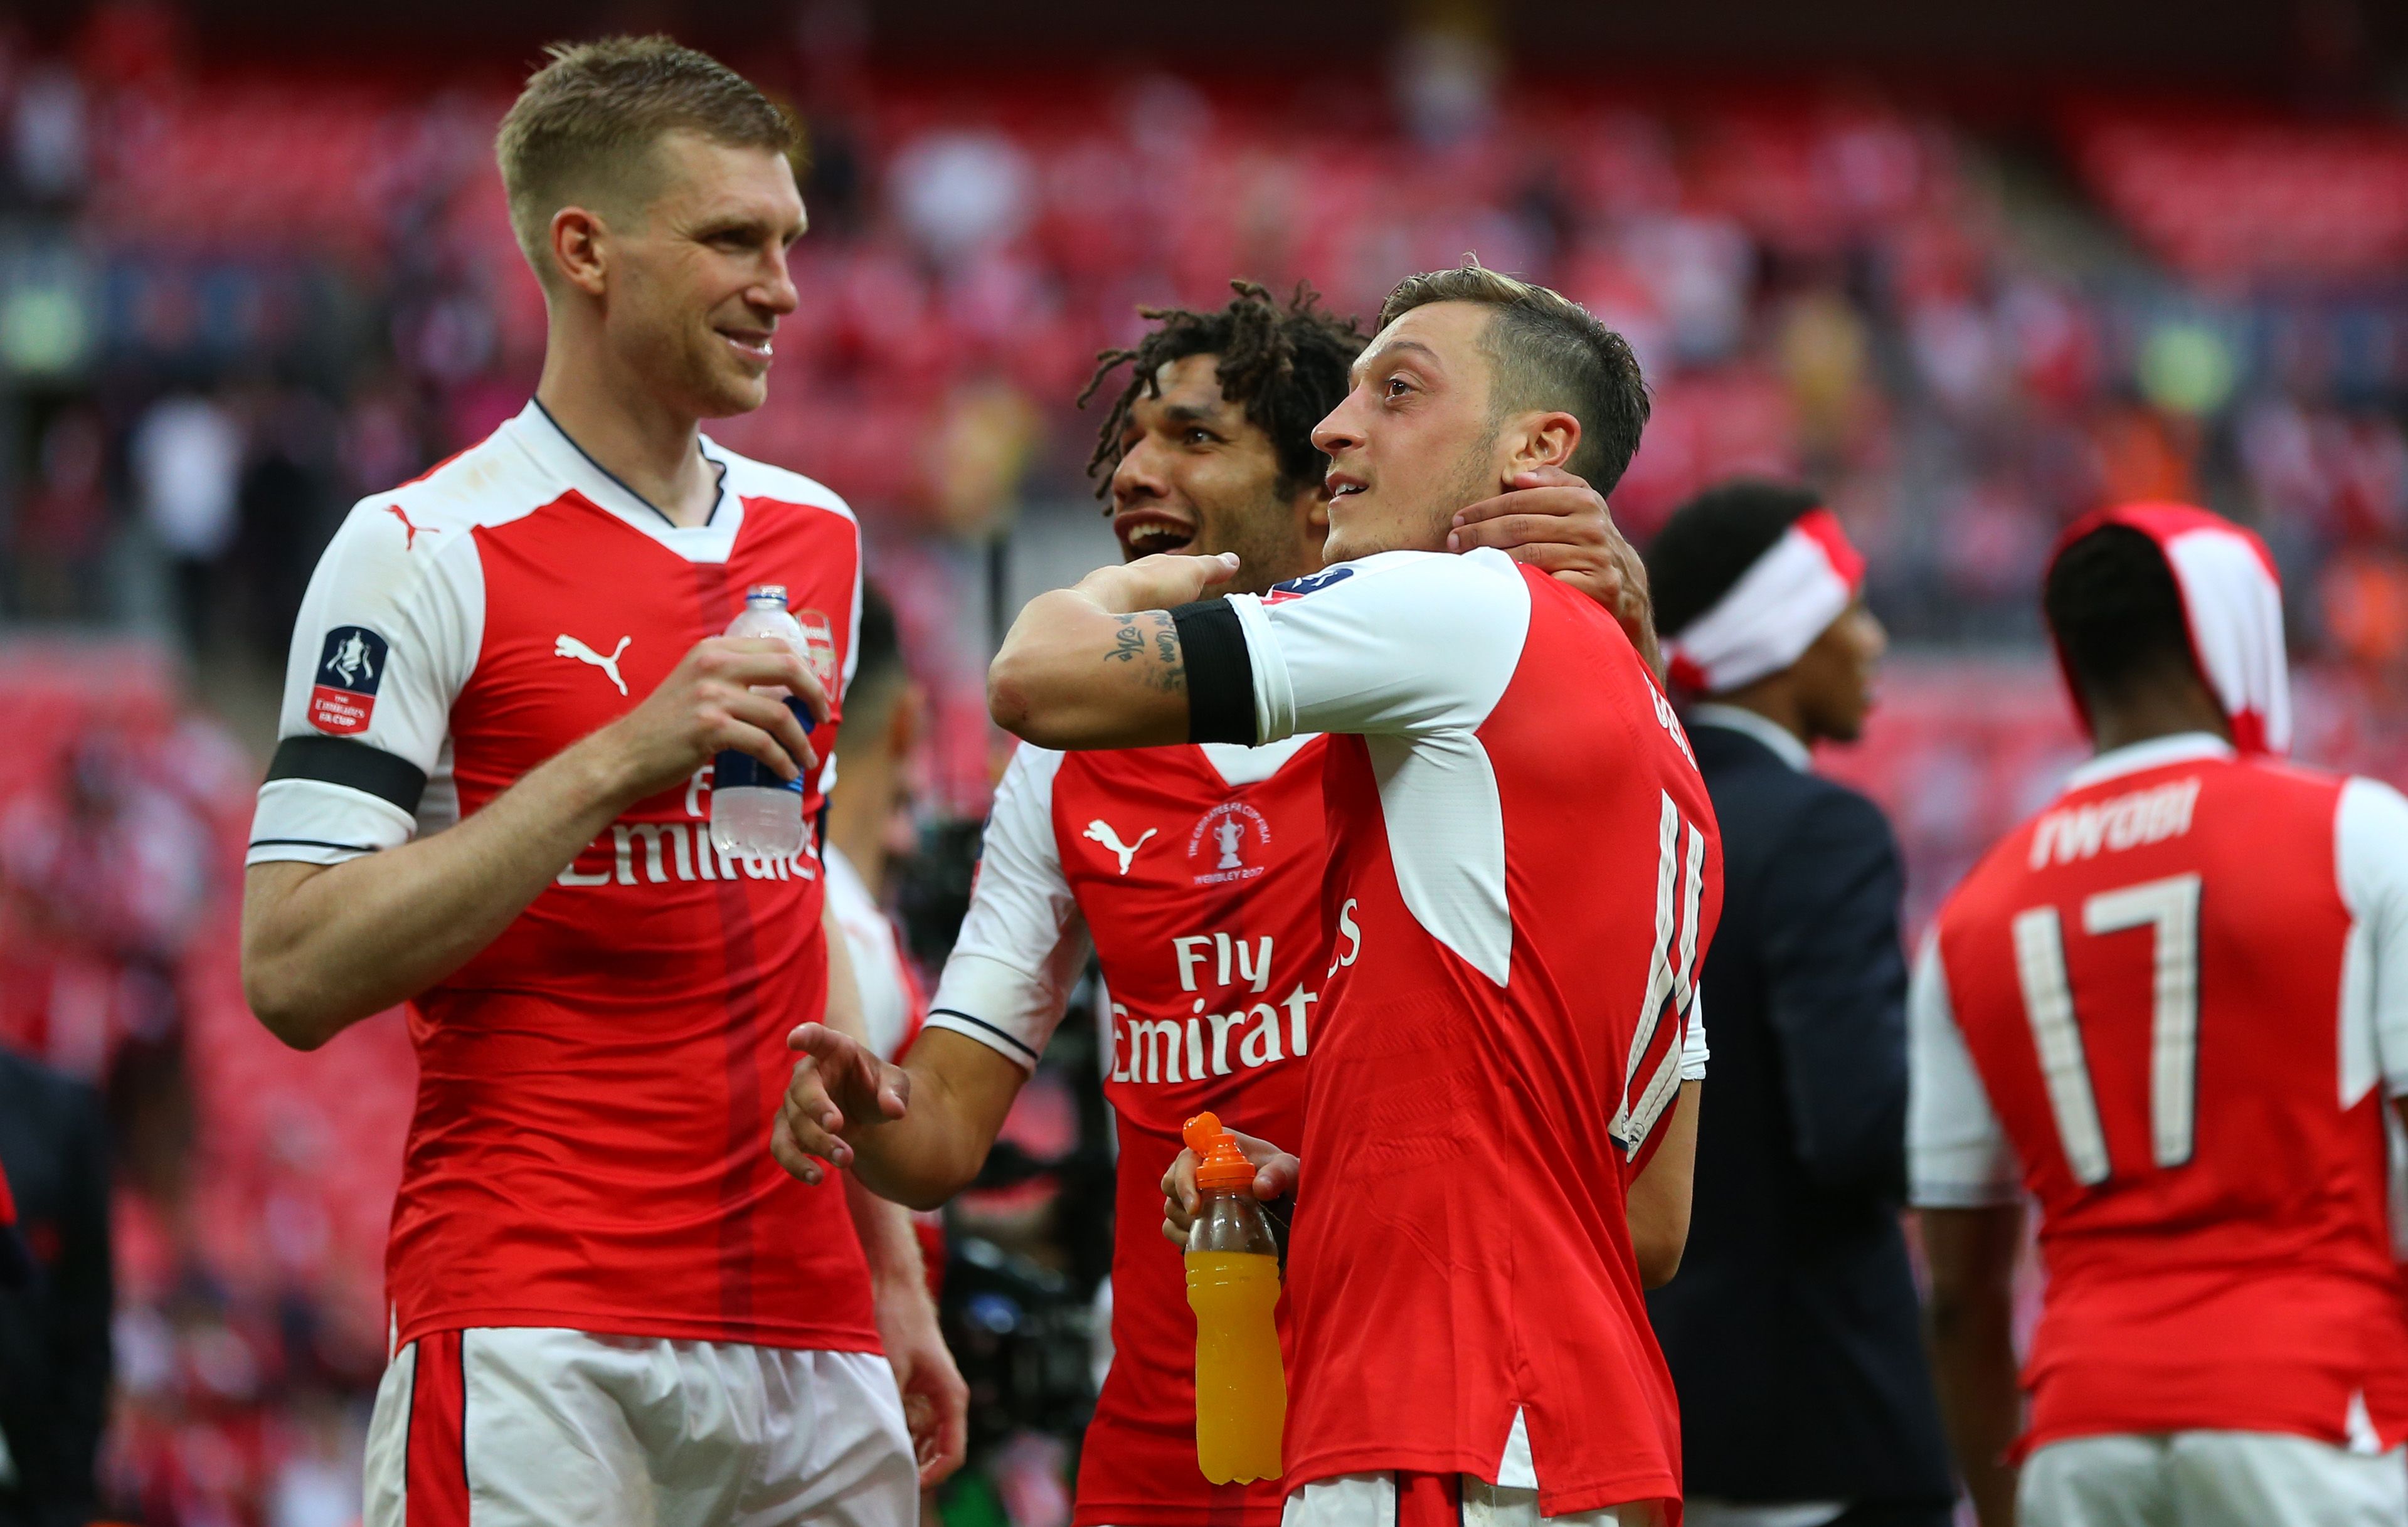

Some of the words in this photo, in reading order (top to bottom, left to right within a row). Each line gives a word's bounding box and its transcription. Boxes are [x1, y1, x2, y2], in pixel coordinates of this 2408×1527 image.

[332, 714, 356, 727] CUP
[1193, 803, 1229, 838] EMIRATES
[1229, 802, 1242, 812] FA
[1242, 805, 1260, 819] CUP
[1256, 818, 1271, 844] FINAL
[2030, 778, 2202, 870] IWOBI
[1194, 870, 1240, 885] WEMBLEY
[1242, 866, 1265, 879] 2017
[1172, 932, 1273, 993] Fly
[1112, 982, 1318, 1084] Emirat
[2012, 872, 2203, 1188] 17
